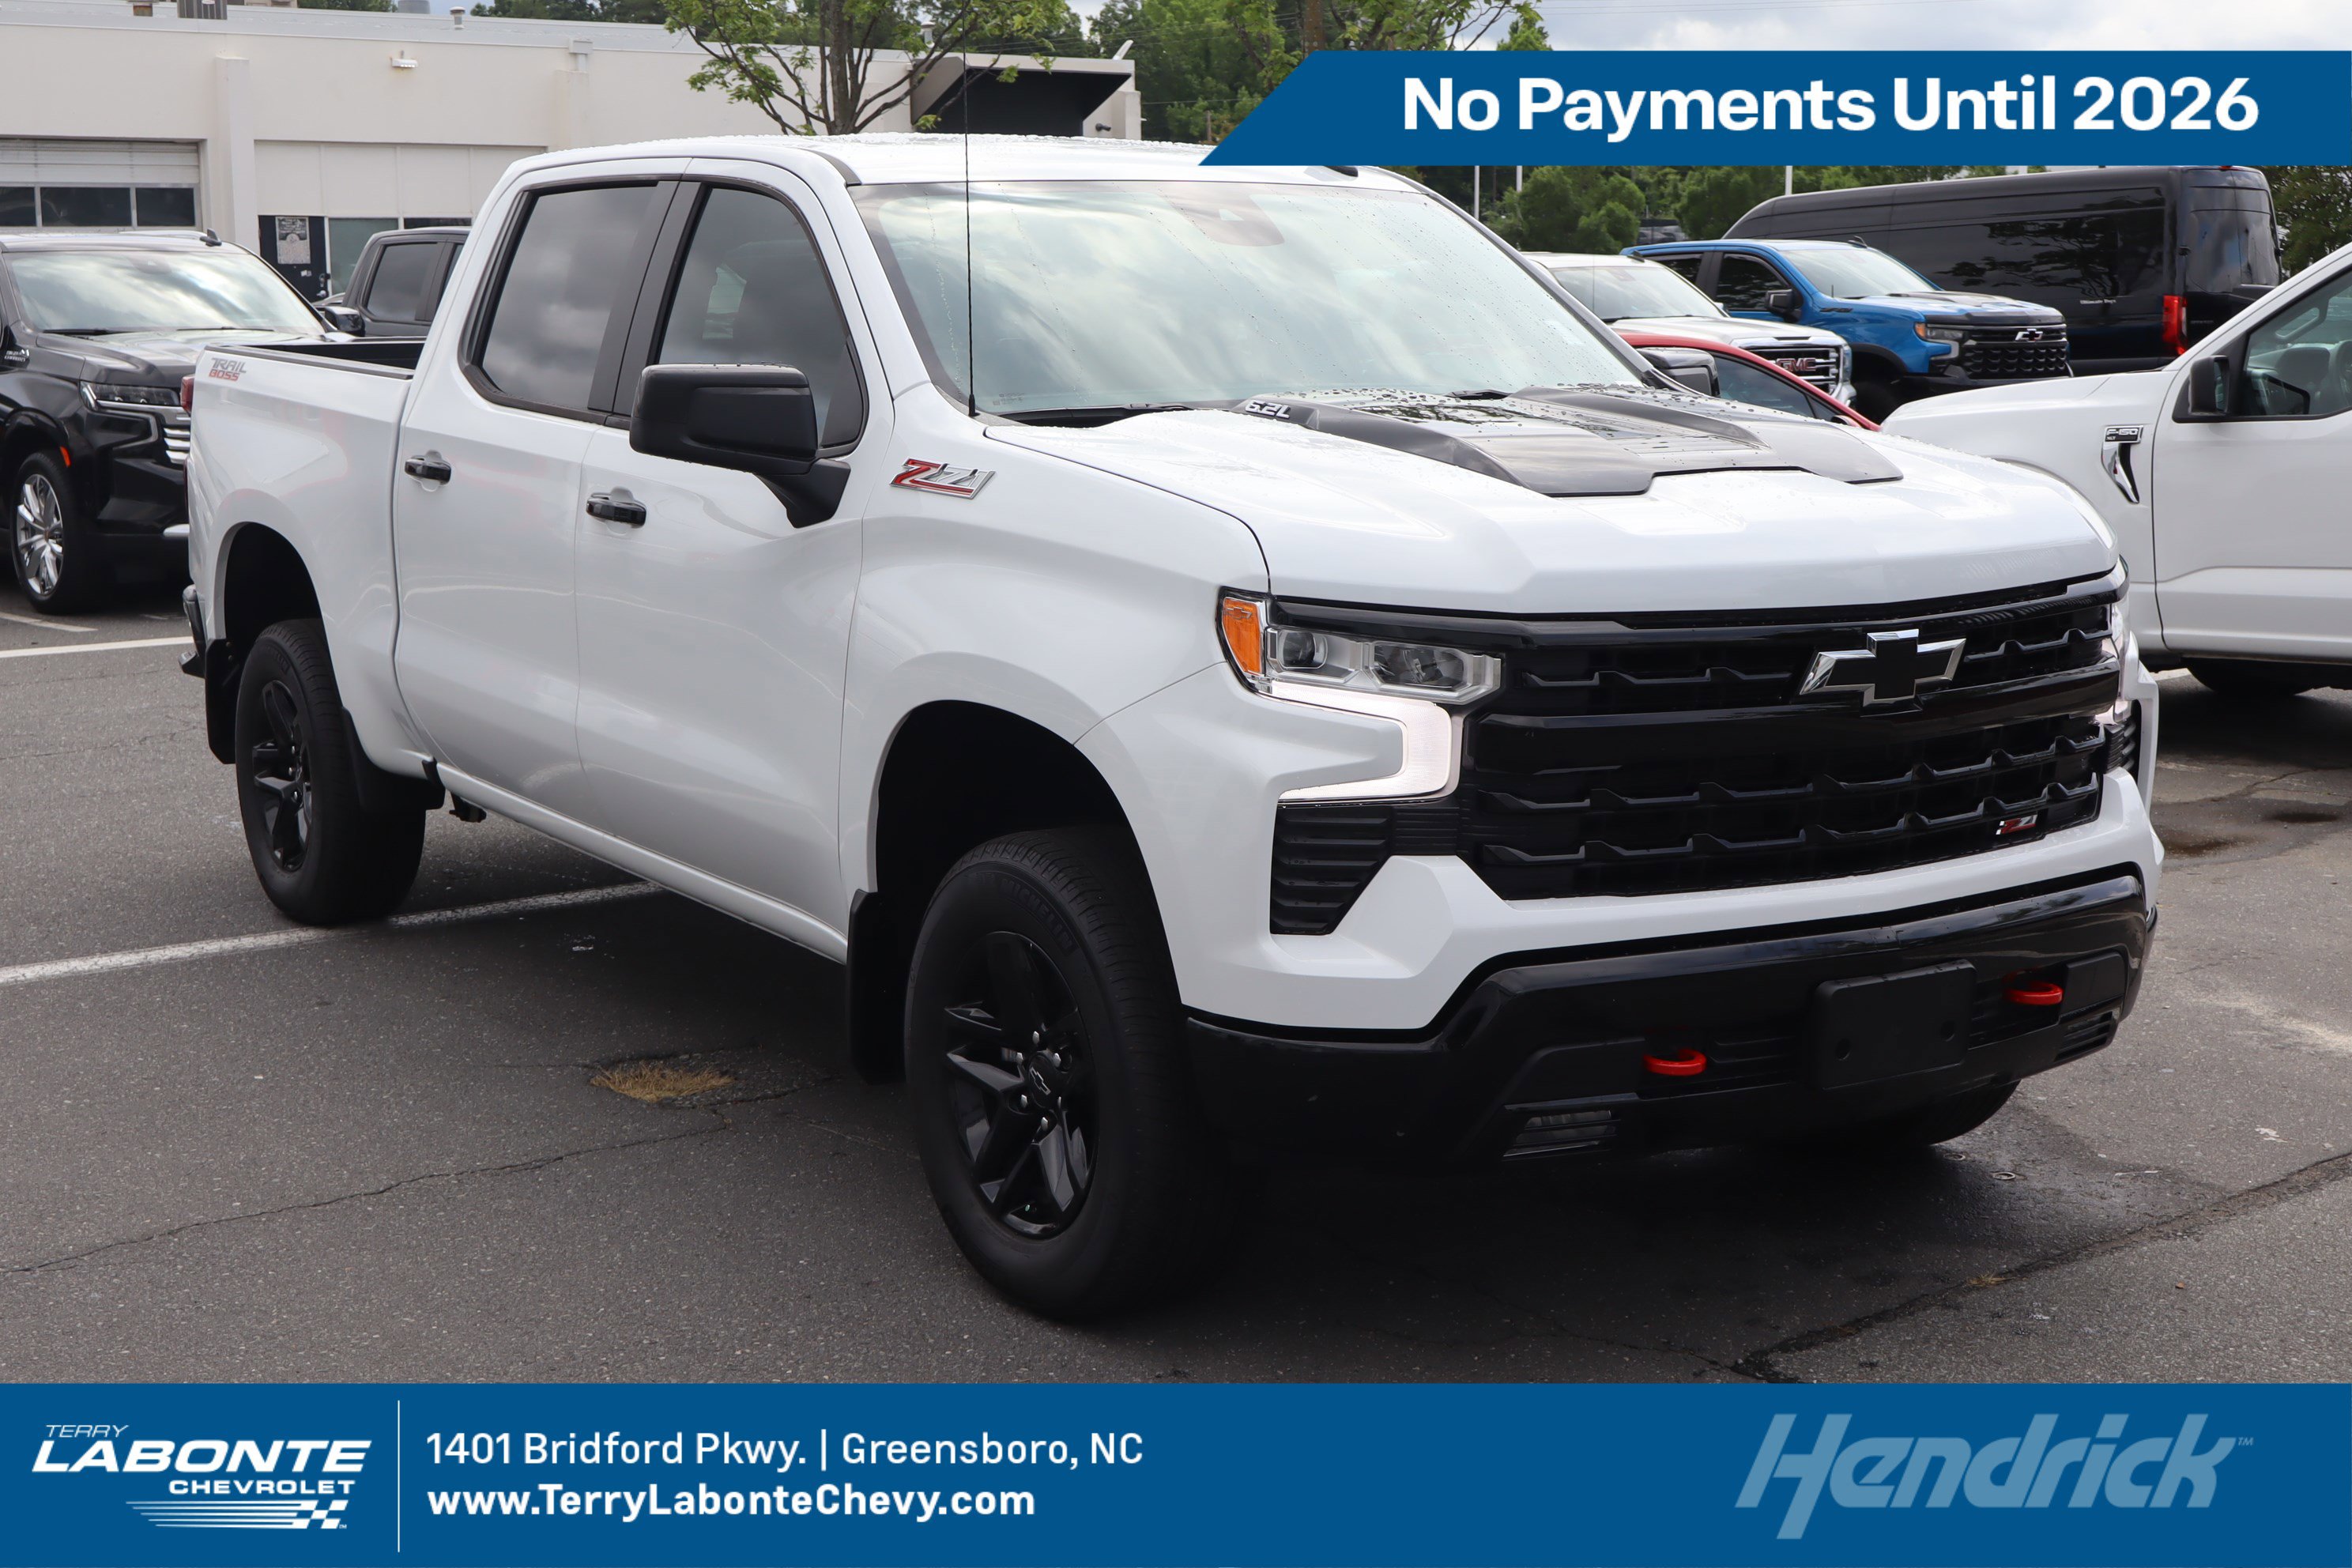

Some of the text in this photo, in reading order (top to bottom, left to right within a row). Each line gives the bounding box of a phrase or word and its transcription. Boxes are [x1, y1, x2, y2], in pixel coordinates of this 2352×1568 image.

[211, 357, 247, 373] TRAIL
[1776, 357, 1816, 371] GMC
[209, 368, 240, 382] BOSS
[1245, 399, 1290, 419] 6.2L
[889, 457, 997, 500] Z71
